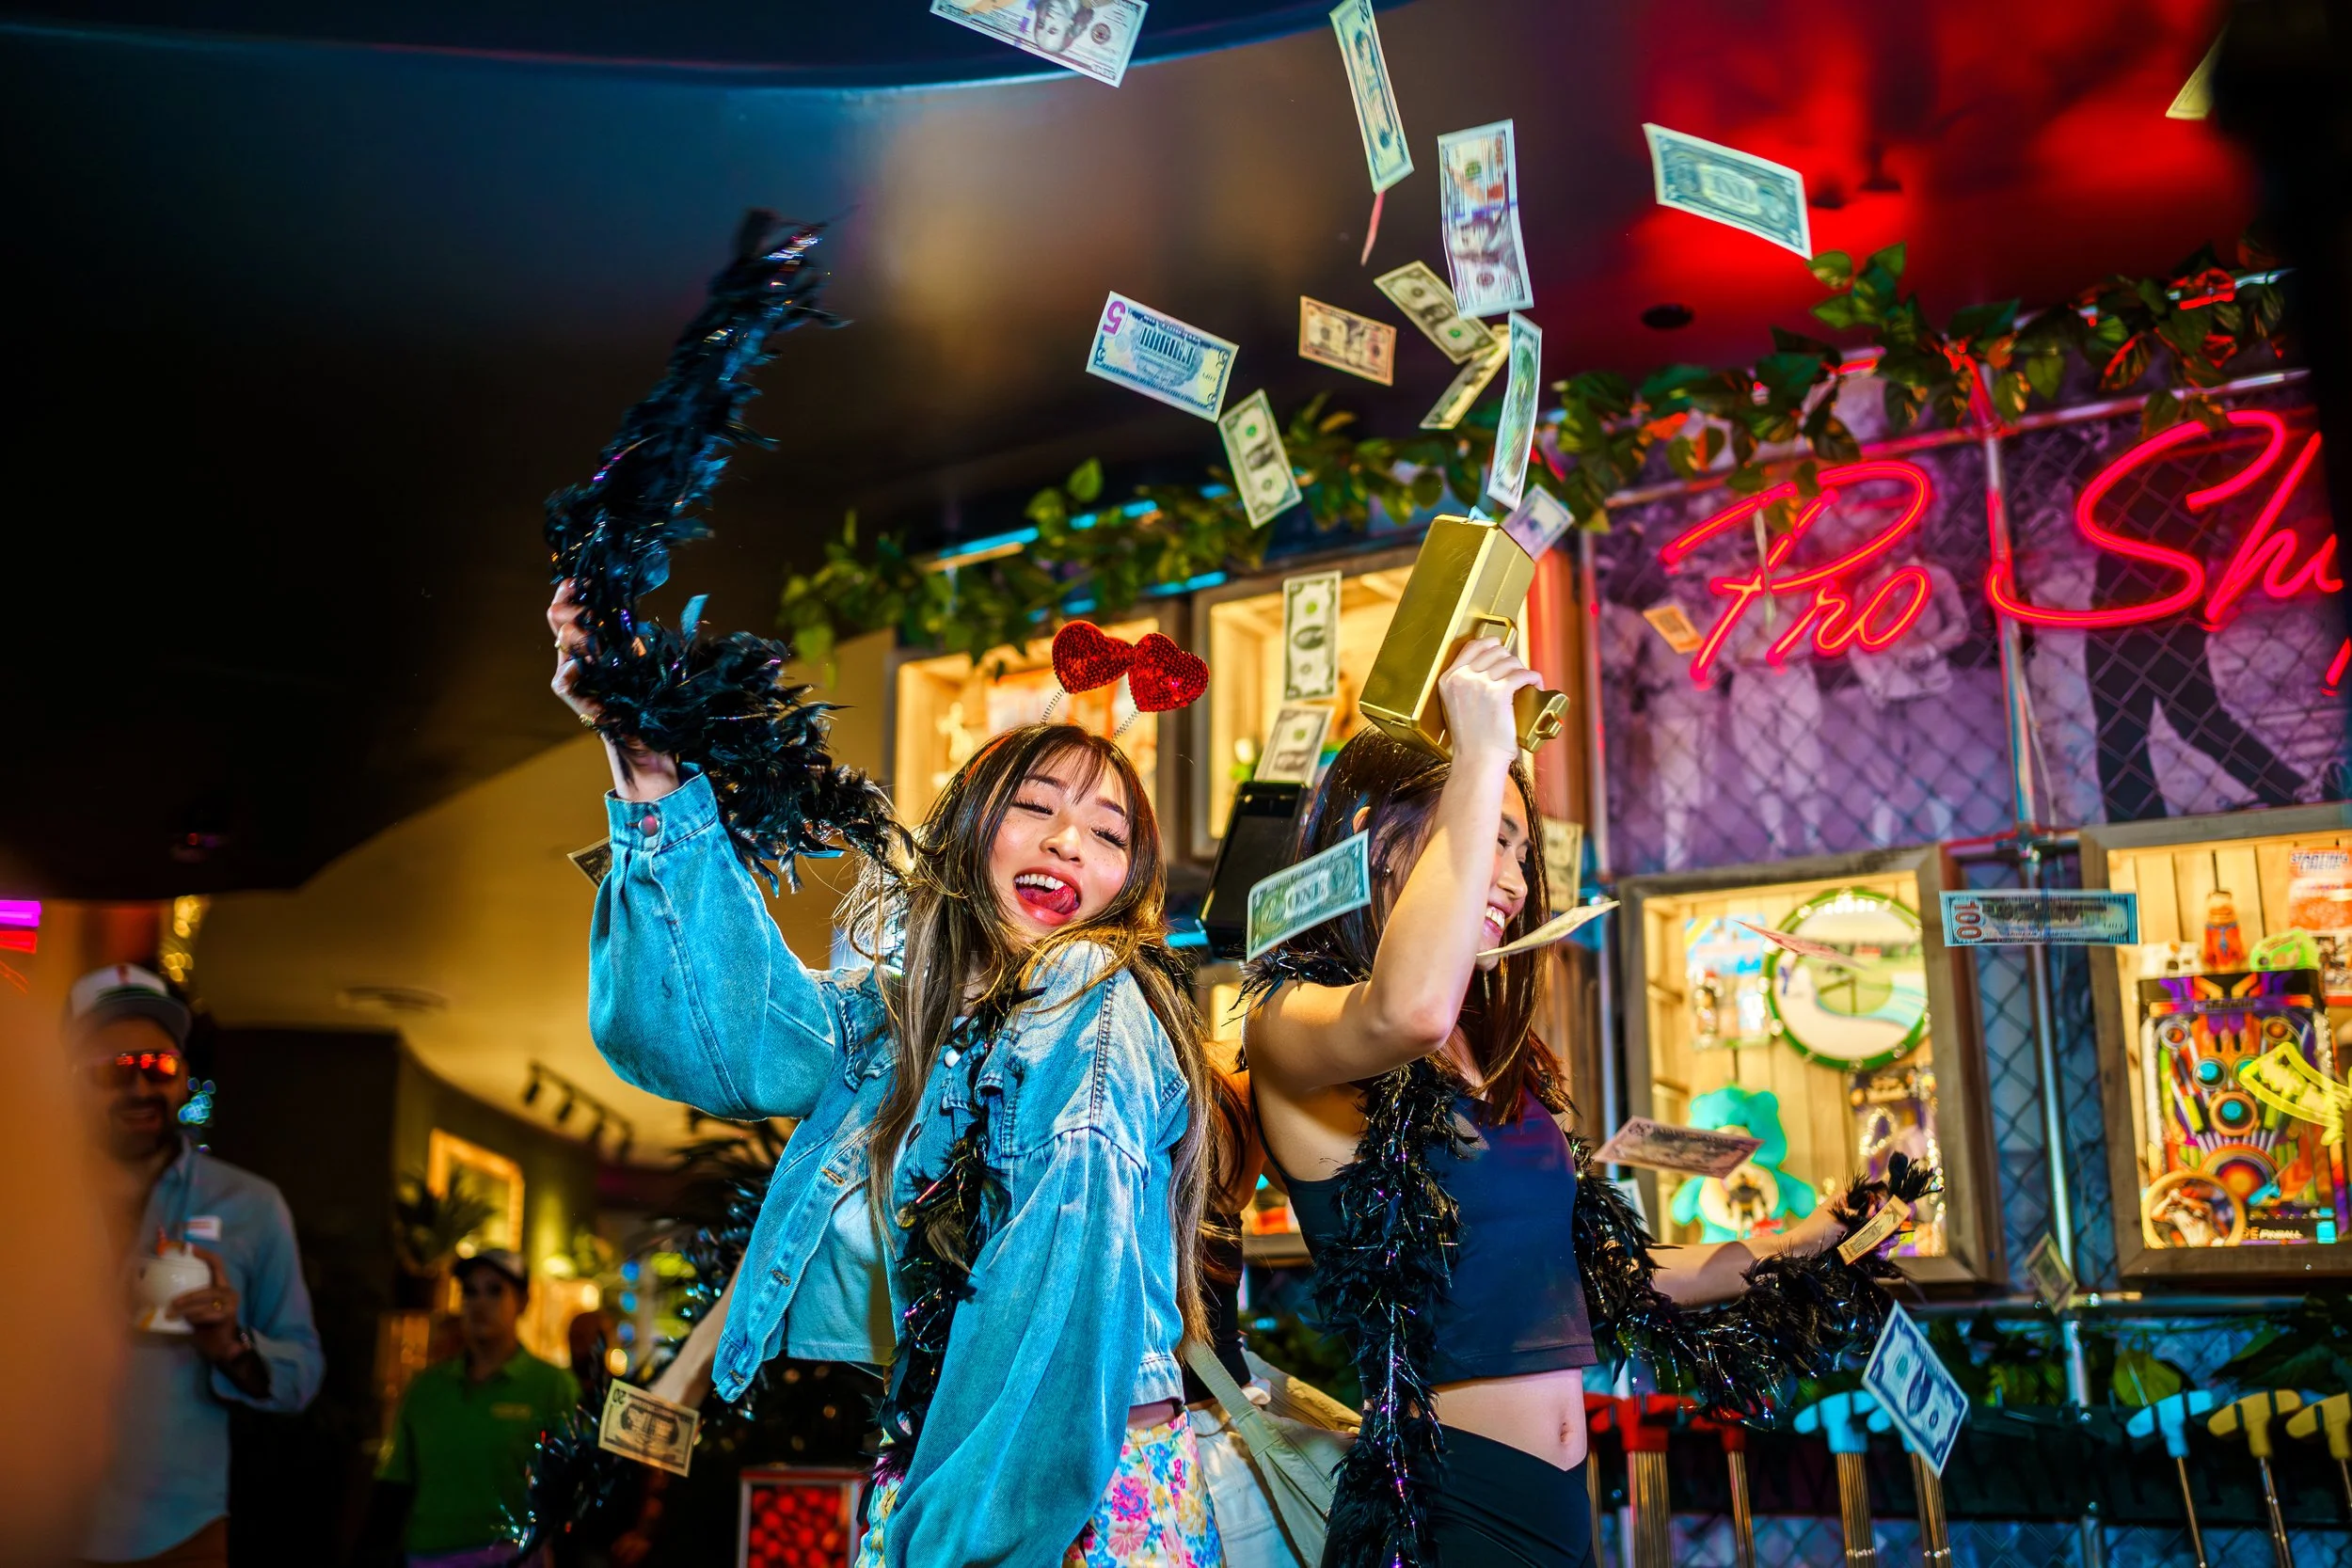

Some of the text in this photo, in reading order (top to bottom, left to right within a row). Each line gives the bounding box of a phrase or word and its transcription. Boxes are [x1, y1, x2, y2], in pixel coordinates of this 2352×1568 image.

[1104, 301, 1125, 335] 5
[1659, 408, 2352, 694] Pro Sh
[1954, 900, 1983, 939] 100
[612, 1388, 627, 1405] 20
